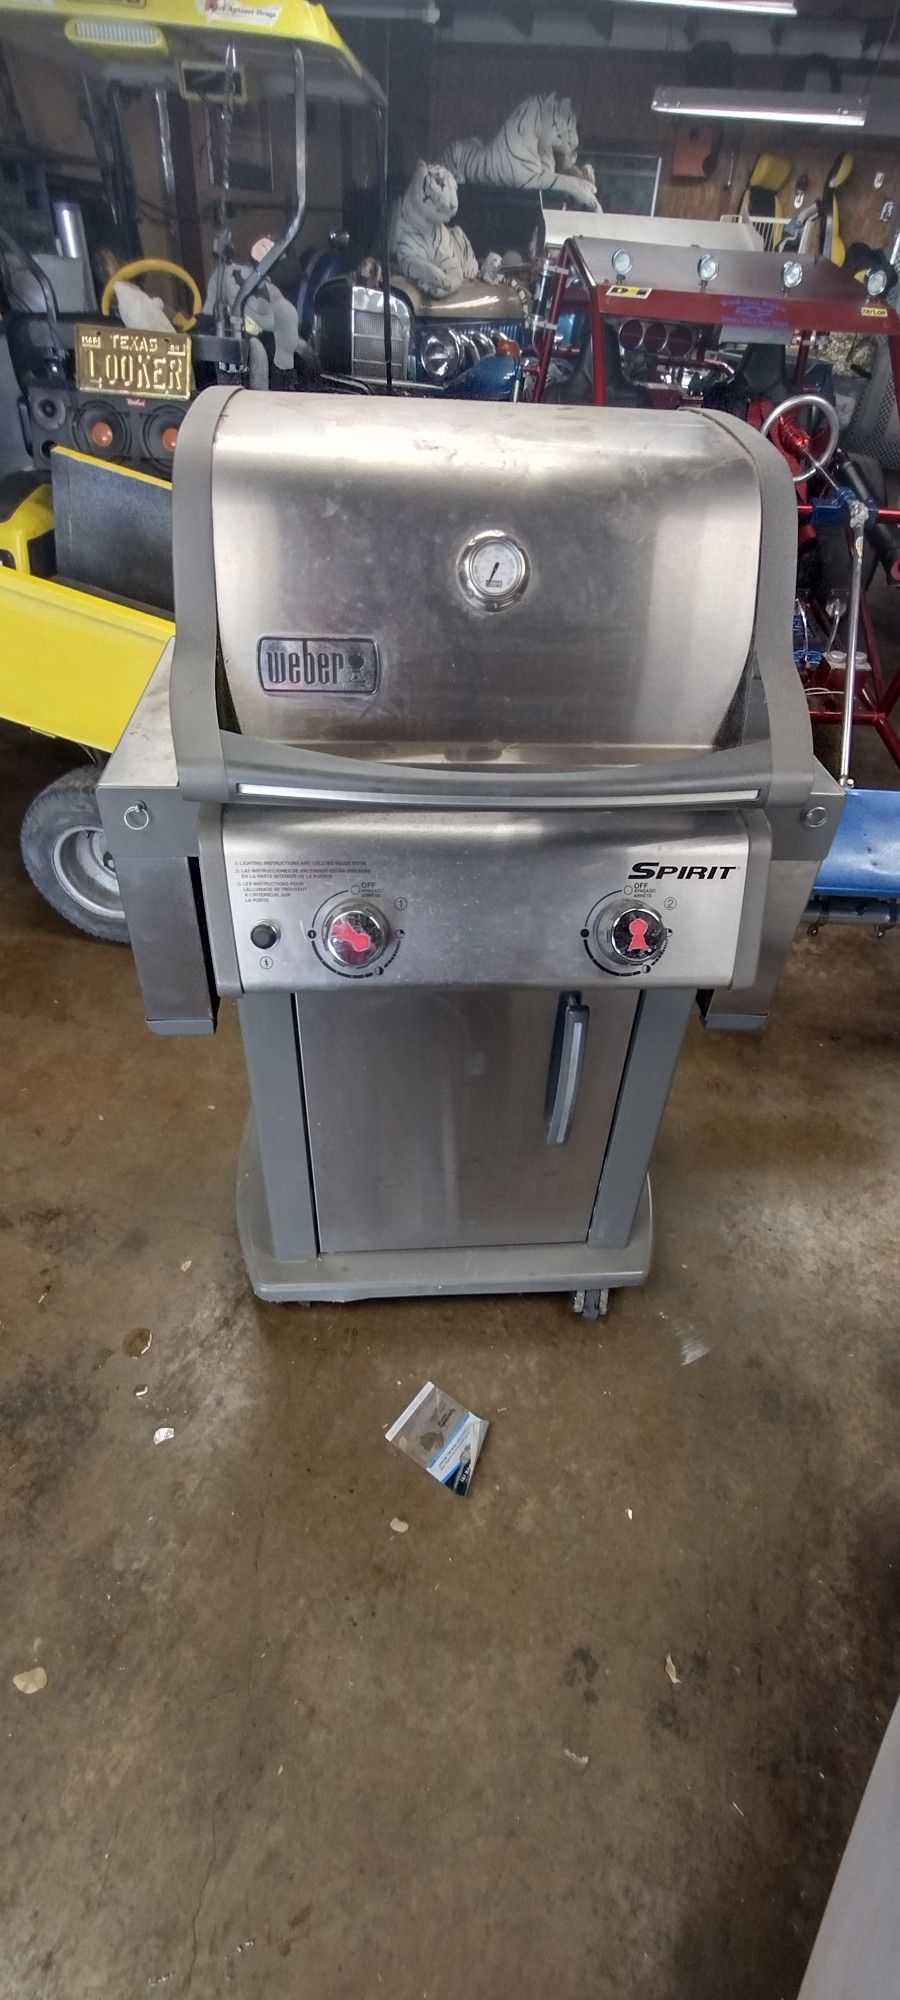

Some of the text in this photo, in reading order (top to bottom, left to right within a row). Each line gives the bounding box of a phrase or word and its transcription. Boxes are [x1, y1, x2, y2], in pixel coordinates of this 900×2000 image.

[110, 334, 158, 352] TEXAS
[89, 350, 183, 390] LOOKER
[266, 640, 344, 685] weber
[628, 862, 736, 879] SPIRIT
[361, 881, 376, 889] OFF
